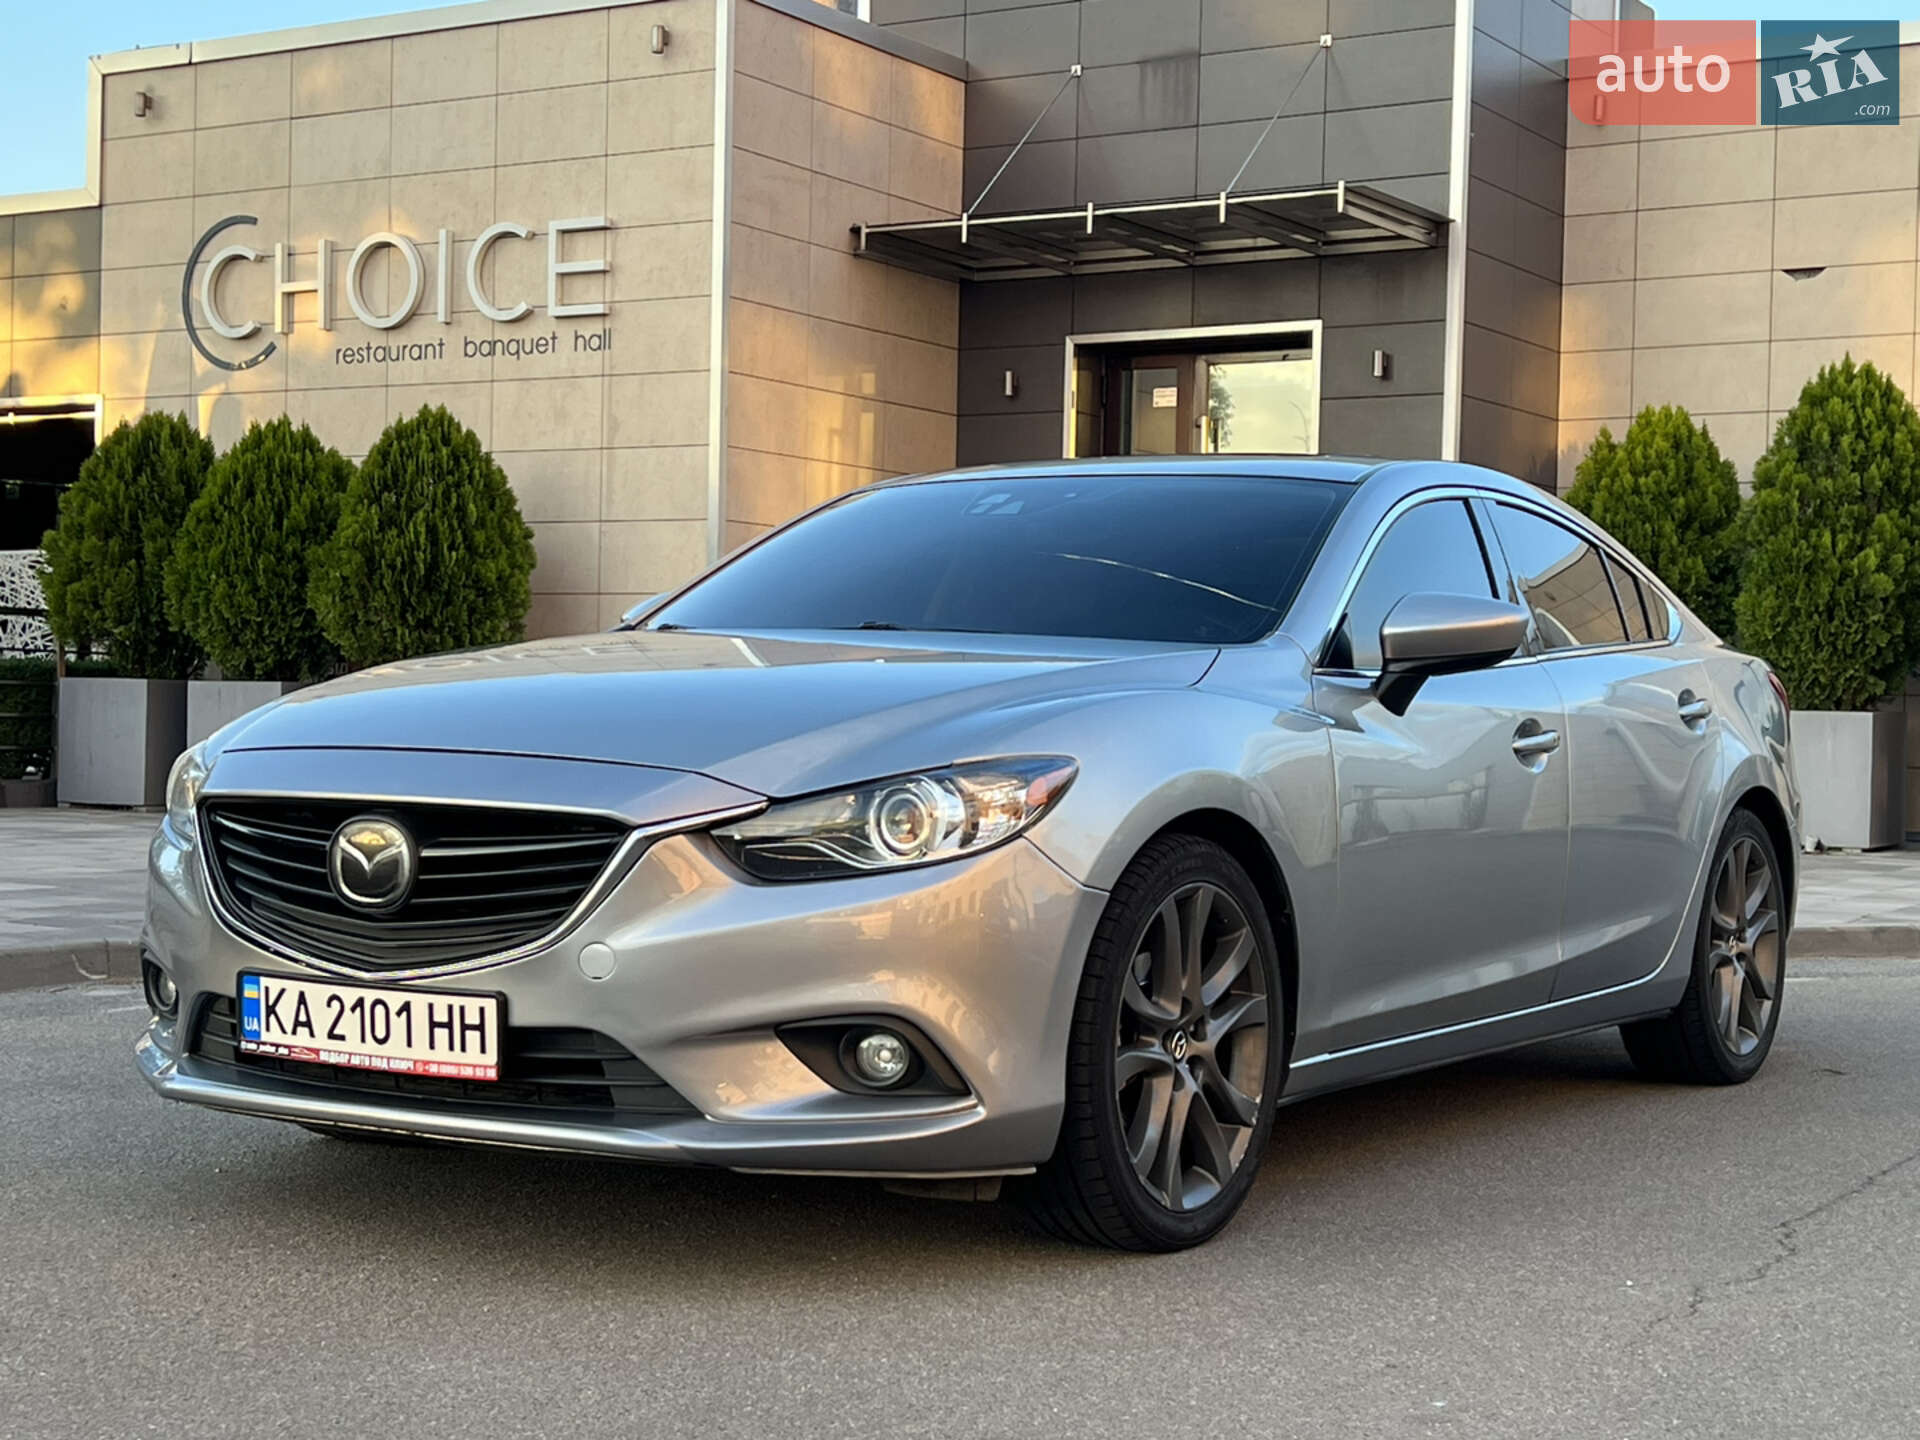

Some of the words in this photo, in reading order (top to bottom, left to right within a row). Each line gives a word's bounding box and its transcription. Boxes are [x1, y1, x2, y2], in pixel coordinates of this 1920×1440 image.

[201, 216, 612, 340] CHOICE
[335, 337, 446, 365] restaurant
[464, 330, 558, 361] banquet
[573, 327, 612, 352] hall
[244, 1016, 260, 1032] UA
[264, 986, 316, 1039] KA
[326, 993, 413, 1048] 2101
[428, 1002, 487, 1055] HH
